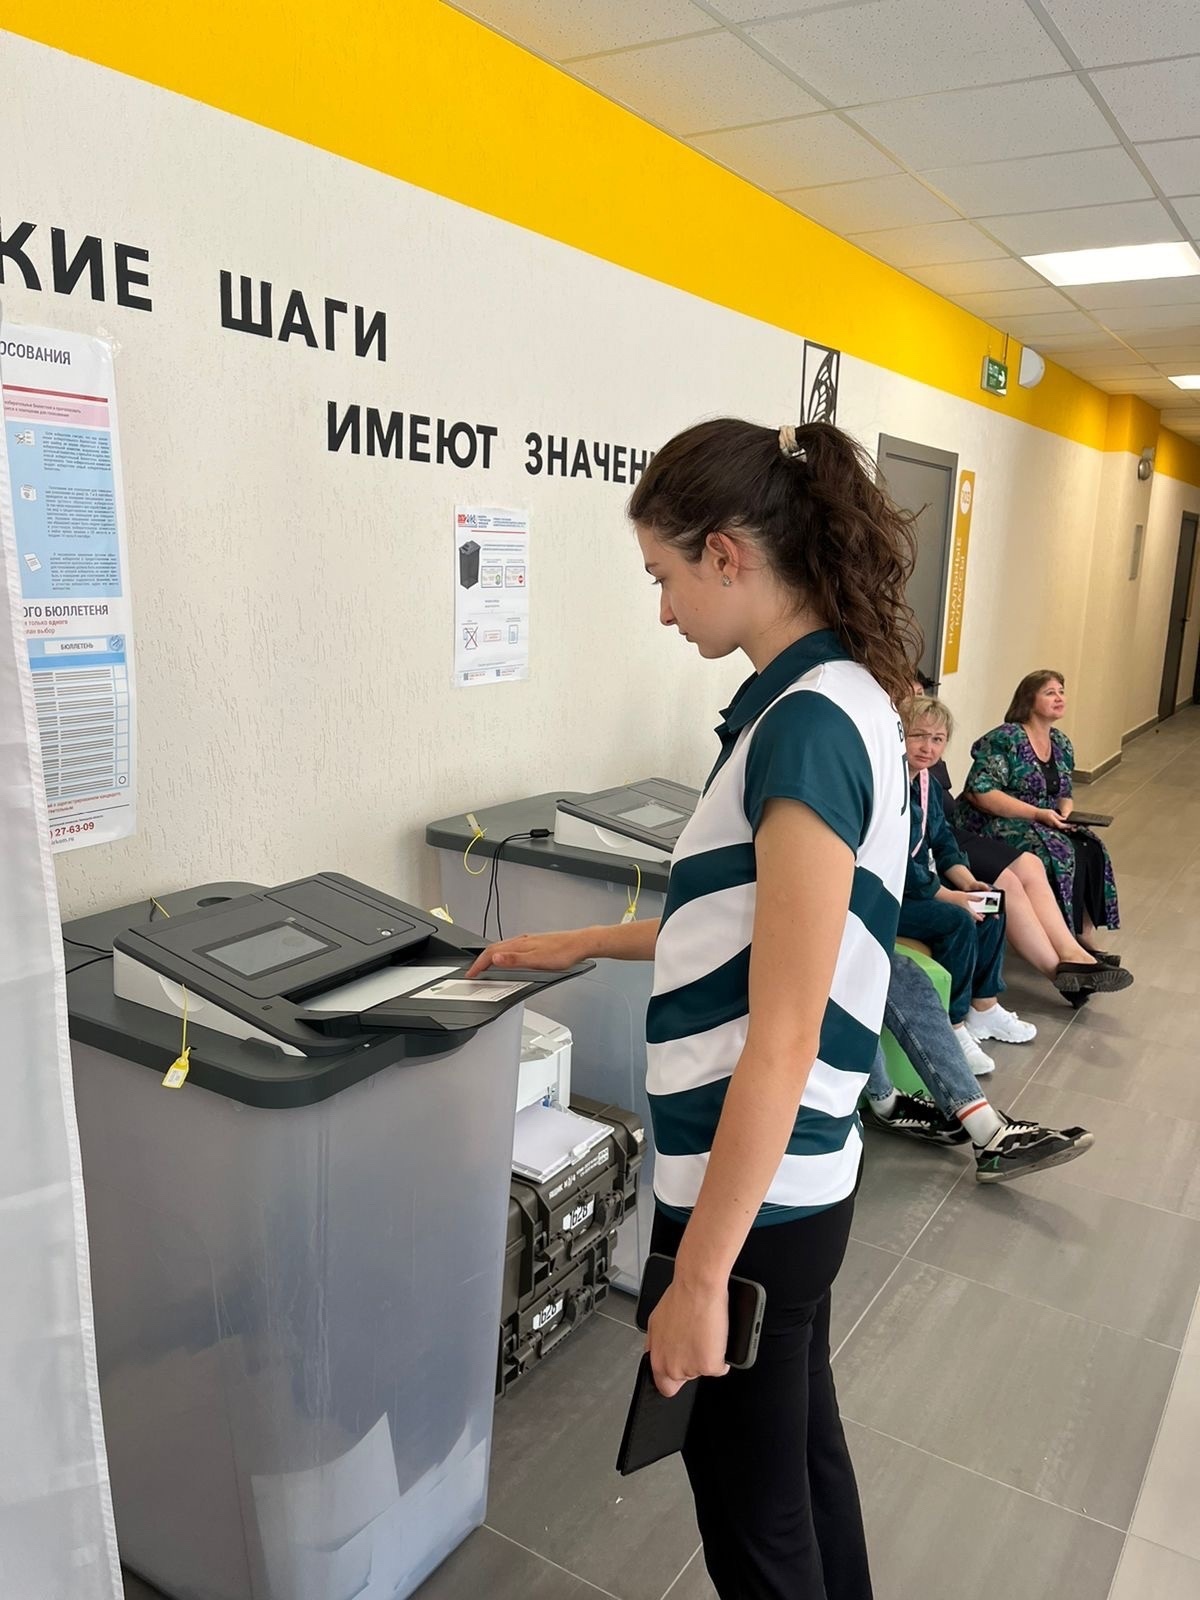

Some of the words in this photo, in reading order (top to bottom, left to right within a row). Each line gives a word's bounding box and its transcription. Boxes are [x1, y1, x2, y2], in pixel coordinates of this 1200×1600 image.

[0, 217, 152, 312] КИЕ
[220, 269, 386, 362] ШАГИ
[0, 341, 71, 365] ОСОВАНИЯ
[327, 400, 498, 469] ИМЕЮТ
[524, 432, 655, 485] ЗНАЧЕН
[45, 604, 109, 617] БЮЛЛЕТЕНЯ
[60, 643, 94, 651] БЮЛЛЕТЕНЬ
[54, 821, 95, 837] 27-63-09
